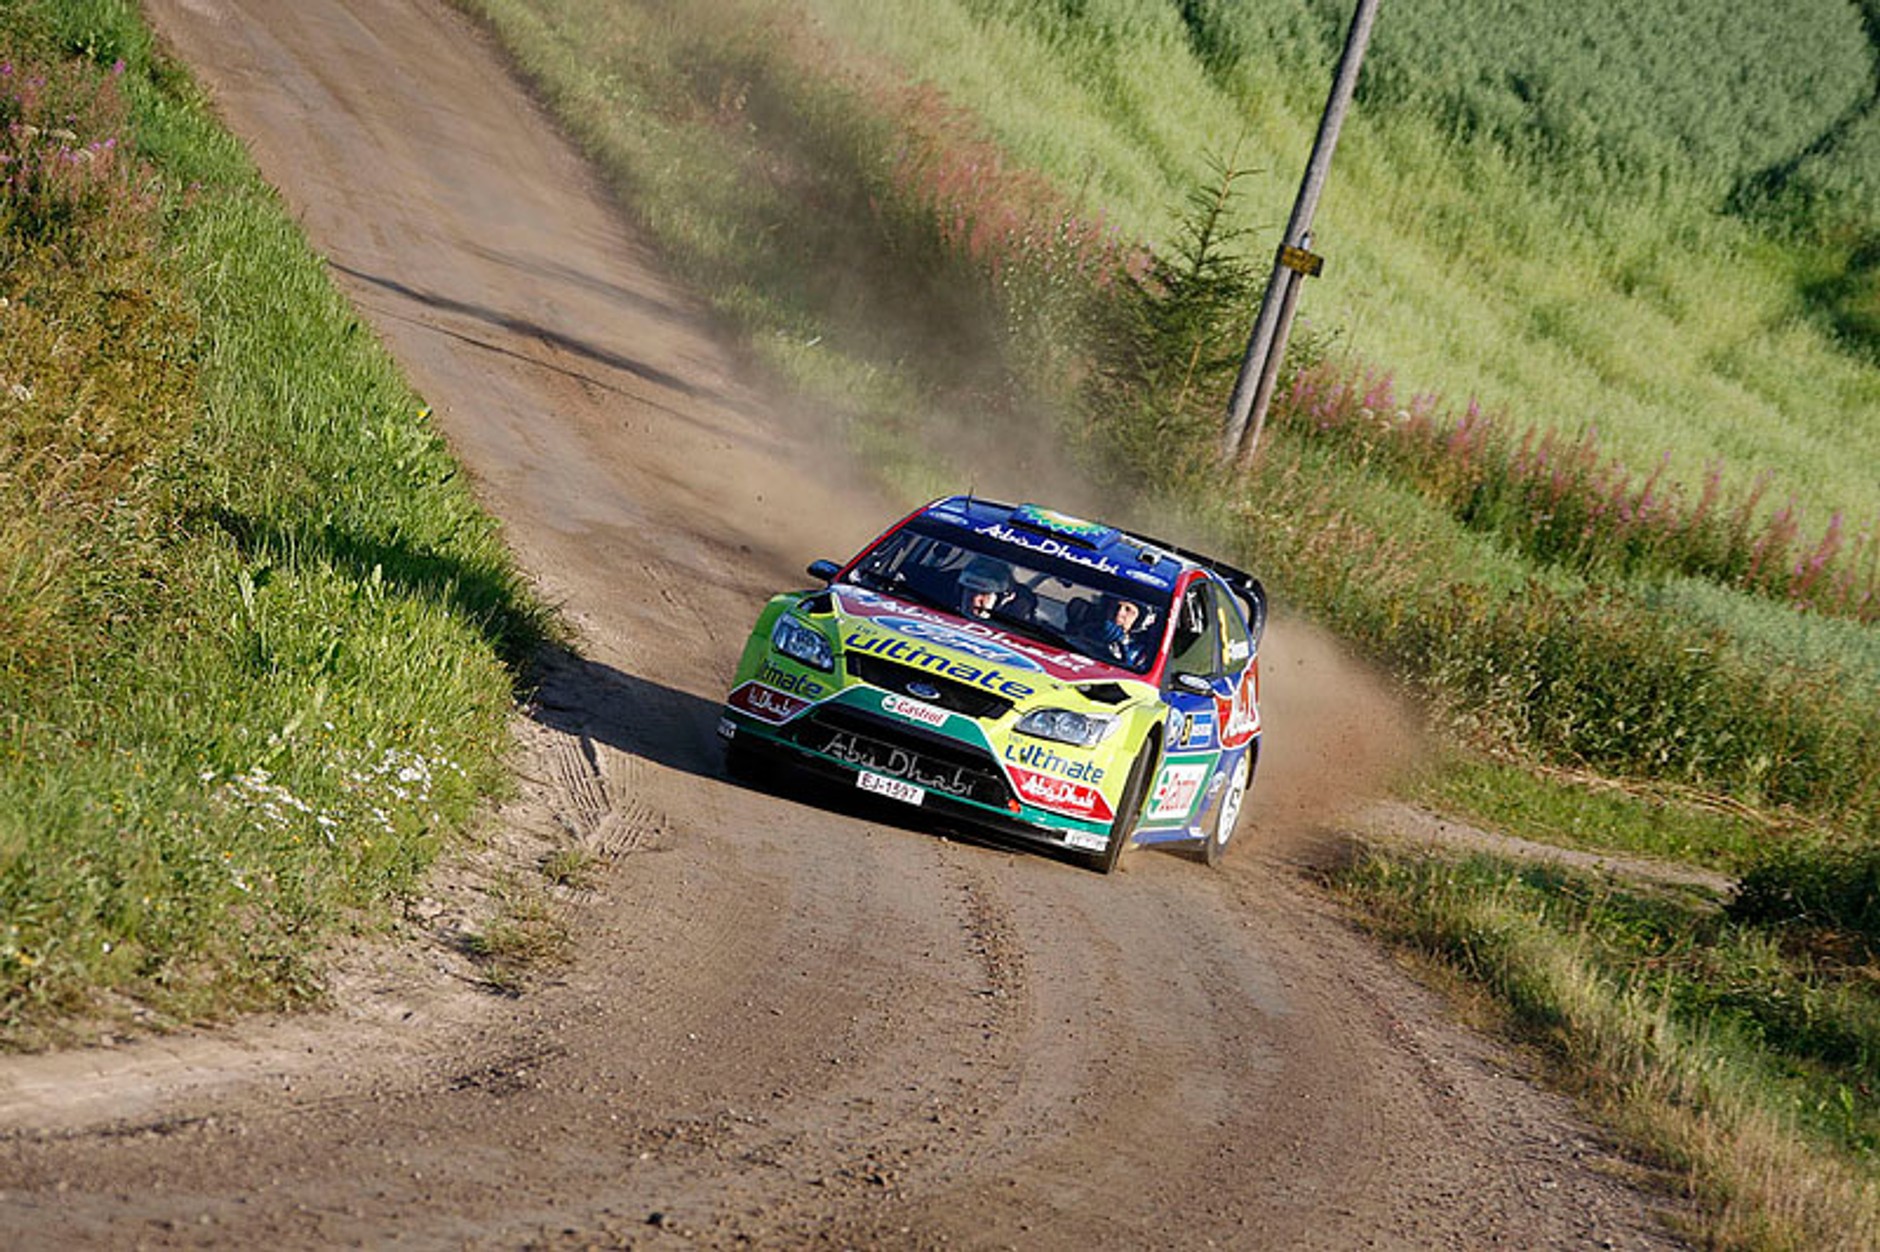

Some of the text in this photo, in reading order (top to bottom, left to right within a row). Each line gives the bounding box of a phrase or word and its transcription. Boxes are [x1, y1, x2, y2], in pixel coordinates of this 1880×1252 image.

[974, 524, 1121, 576] Abu Dhabi
[845, 633, 1034, 700] ultimate
[897, 700, 944, 725] Castrol
[822, 732, 976, 796] Abu Dhabi
[1005, 744, 1105, 784] ultimate
